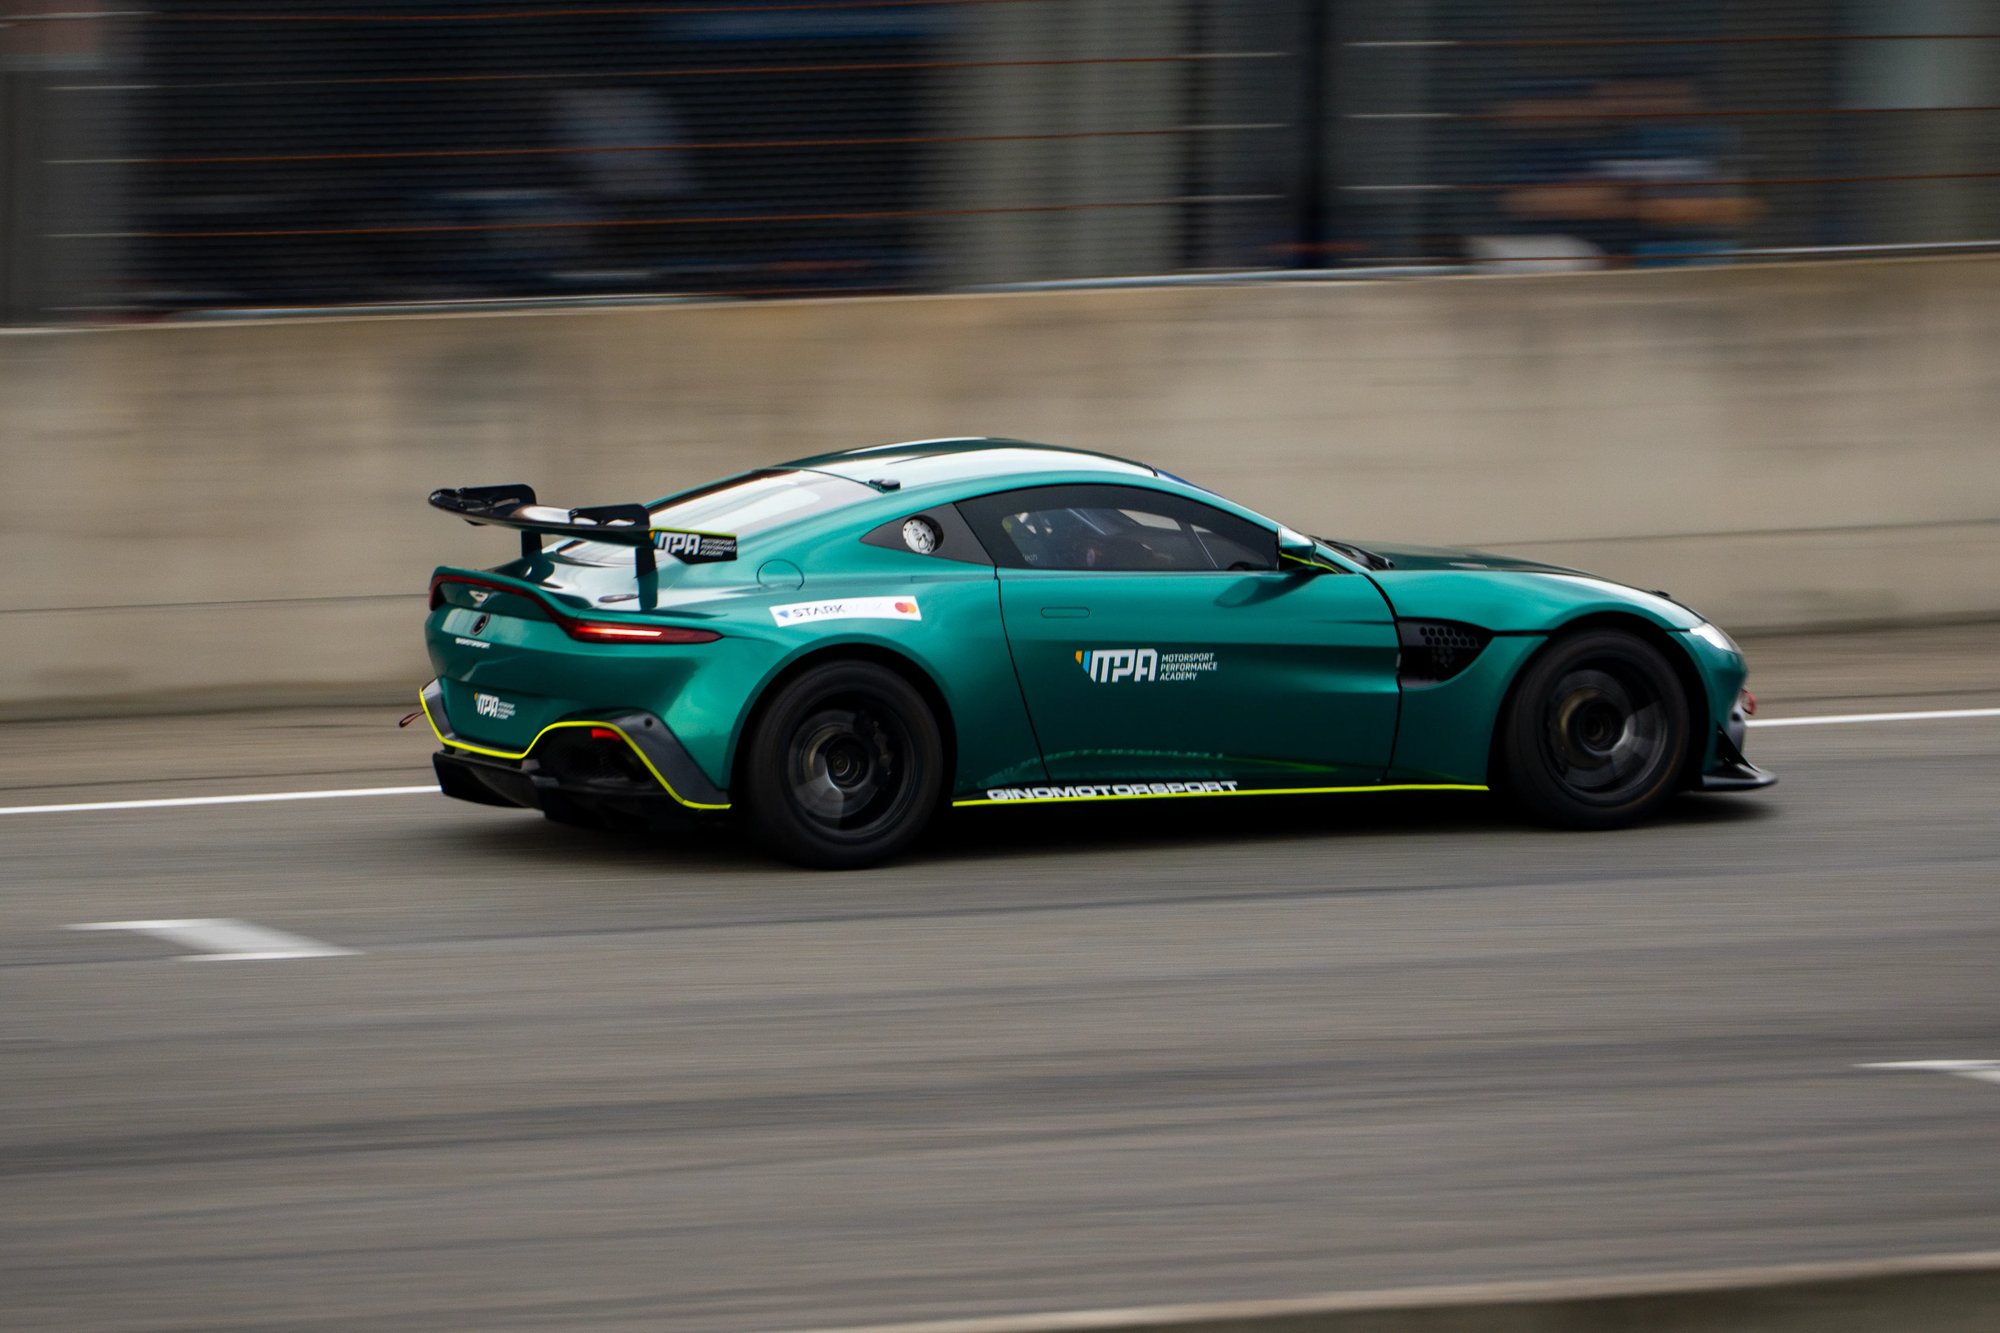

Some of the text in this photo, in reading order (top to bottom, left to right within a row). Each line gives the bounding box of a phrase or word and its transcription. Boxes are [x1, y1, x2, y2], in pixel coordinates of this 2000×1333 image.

[657, 531, 701, 555] MPA
[792, 604, 846, 618] STARK
[1161, 652, 1215, 663] MOTORSPORT
[1089, 648, 1158, 683] MPA
[1160, 661, 1218, 672] PERFORMANCE
[1159, 672, 1198, 682] ACADEMY
